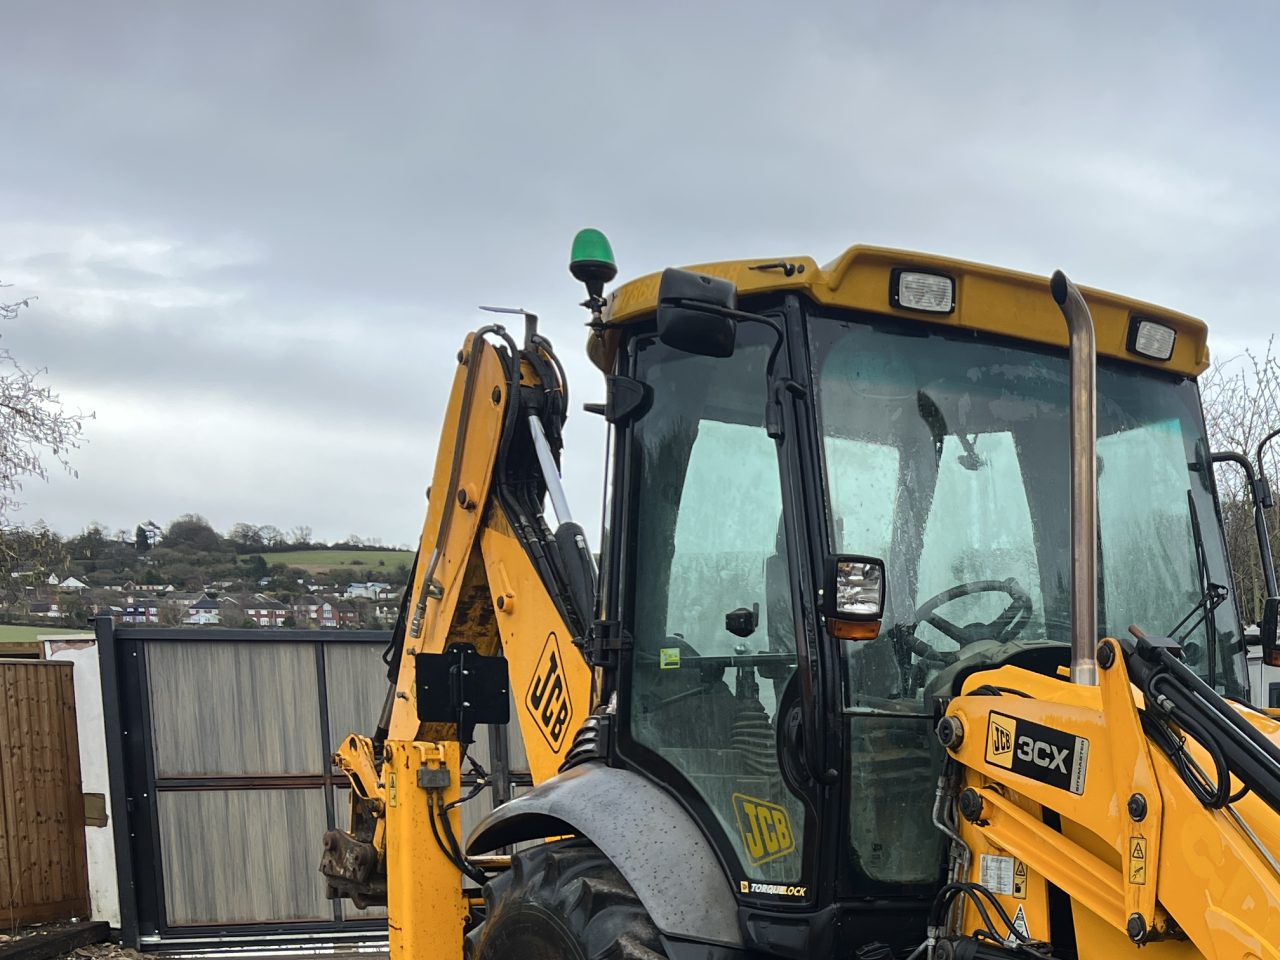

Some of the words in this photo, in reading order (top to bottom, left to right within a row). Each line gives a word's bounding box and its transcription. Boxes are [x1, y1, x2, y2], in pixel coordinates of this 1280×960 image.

[531, 651, 568, 742] JCB
[994, 726, 1010, 752] JCB
[1017, 736, 1069, 774] 3CX
[1075, 740, 1085, 792] SITEMASTER
[743, 802, 790, 858] JCB
[750, 883, 806, 896] TORQUELOCK
